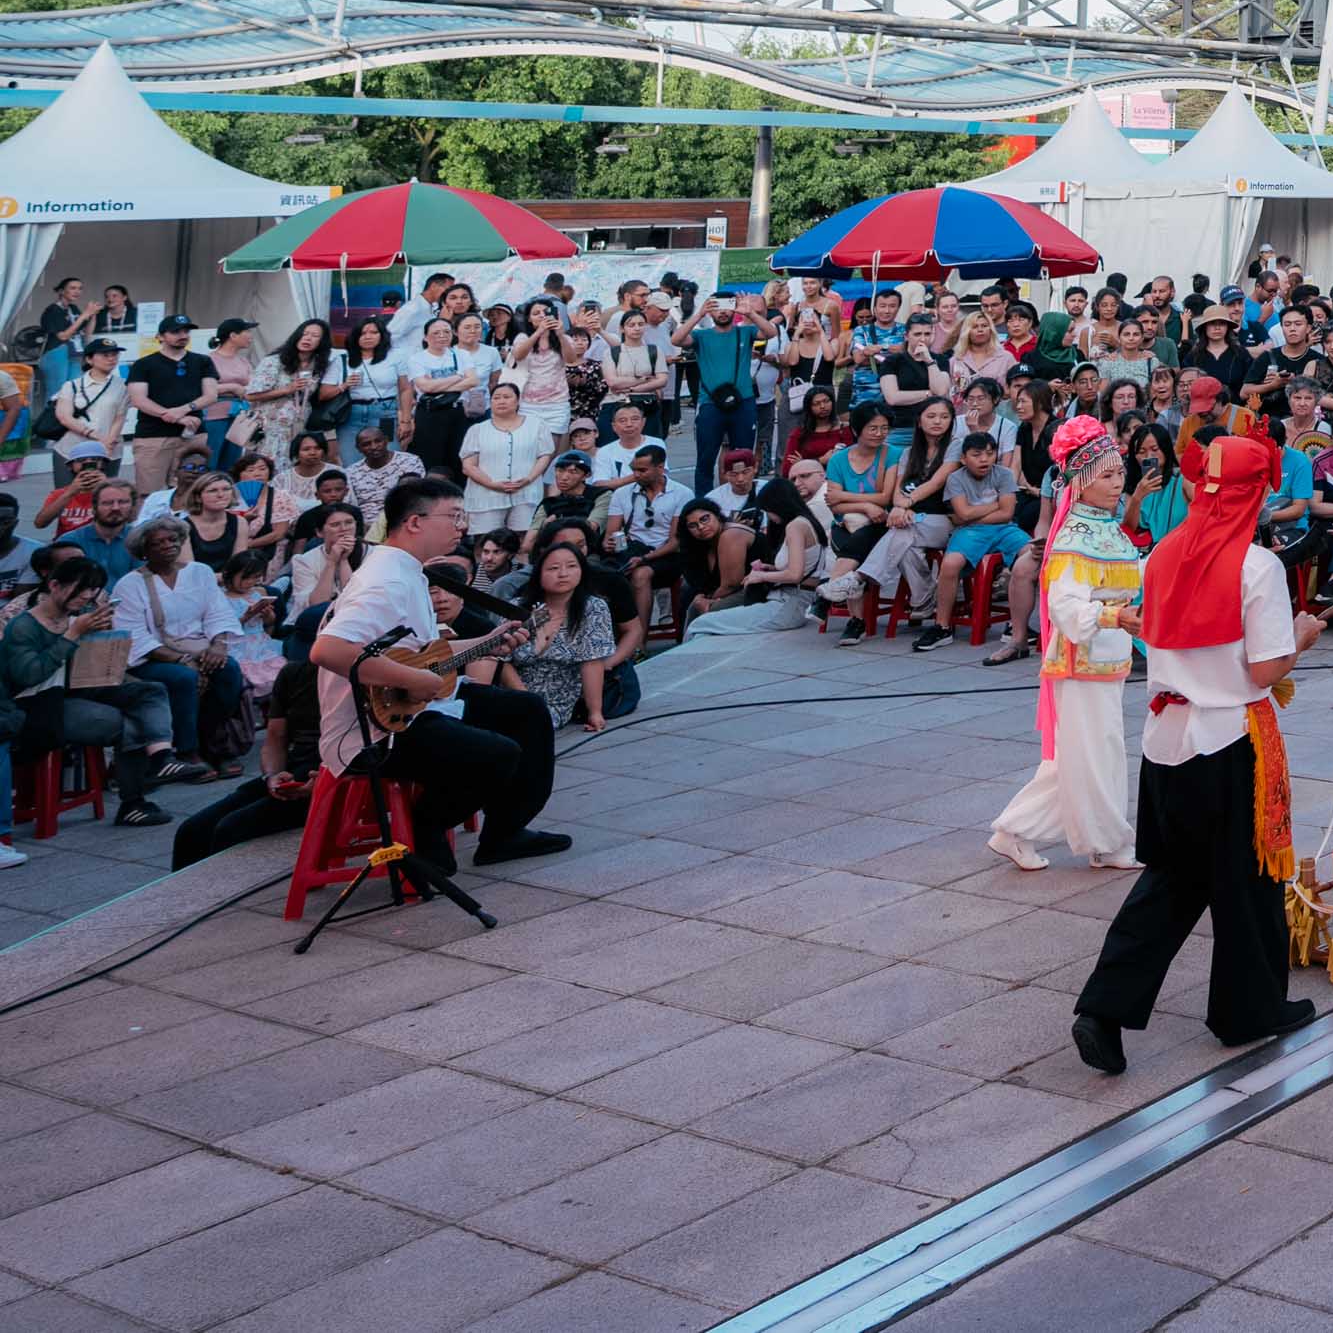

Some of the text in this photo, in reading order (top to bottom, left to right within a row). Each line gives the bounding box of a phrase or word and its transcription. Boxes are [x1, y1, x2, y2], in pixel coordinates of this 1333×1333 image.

[1250, 181, 1295, 191] Information
[26, 199, 134, 213] Information
[279, 194, 319, 207] 資訊站
